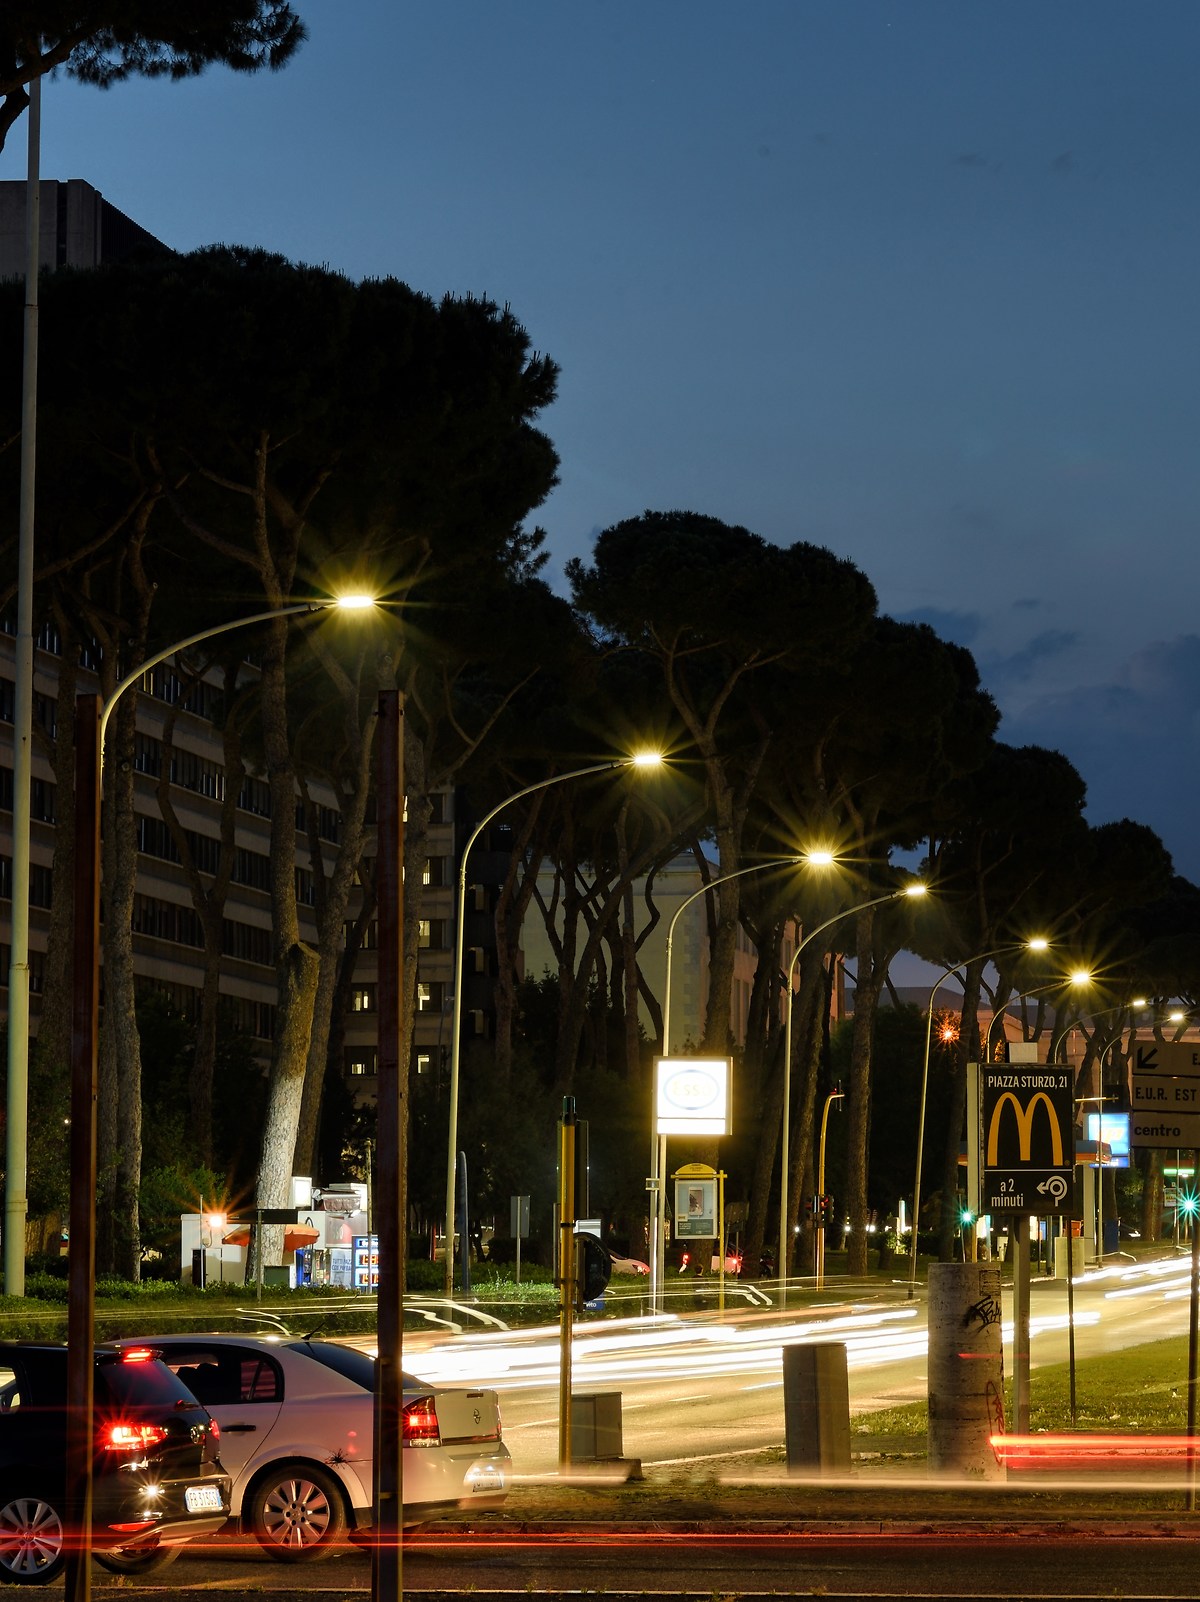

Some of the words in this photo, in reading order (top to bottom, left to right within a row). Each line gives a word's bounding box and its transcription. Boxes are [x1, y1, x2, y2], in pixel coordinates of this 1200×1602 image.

[988, 1075, 1020, 1088] PIAZZA
[1020, 1075, 1058, 1090] STURZO,
[1058, 1075, 1068, 1088] 21
[1135, 1087, 1168, 1100] E.U.R.
[1175, 1088, 1197, 1101] EST
[1134, 1124, 1181, 1137] centro
[1000, 1181, 1006, 1192] a
[1008, 1178, 1015, 1192] 2
[991, 1193, 1024, 1207] minuti
